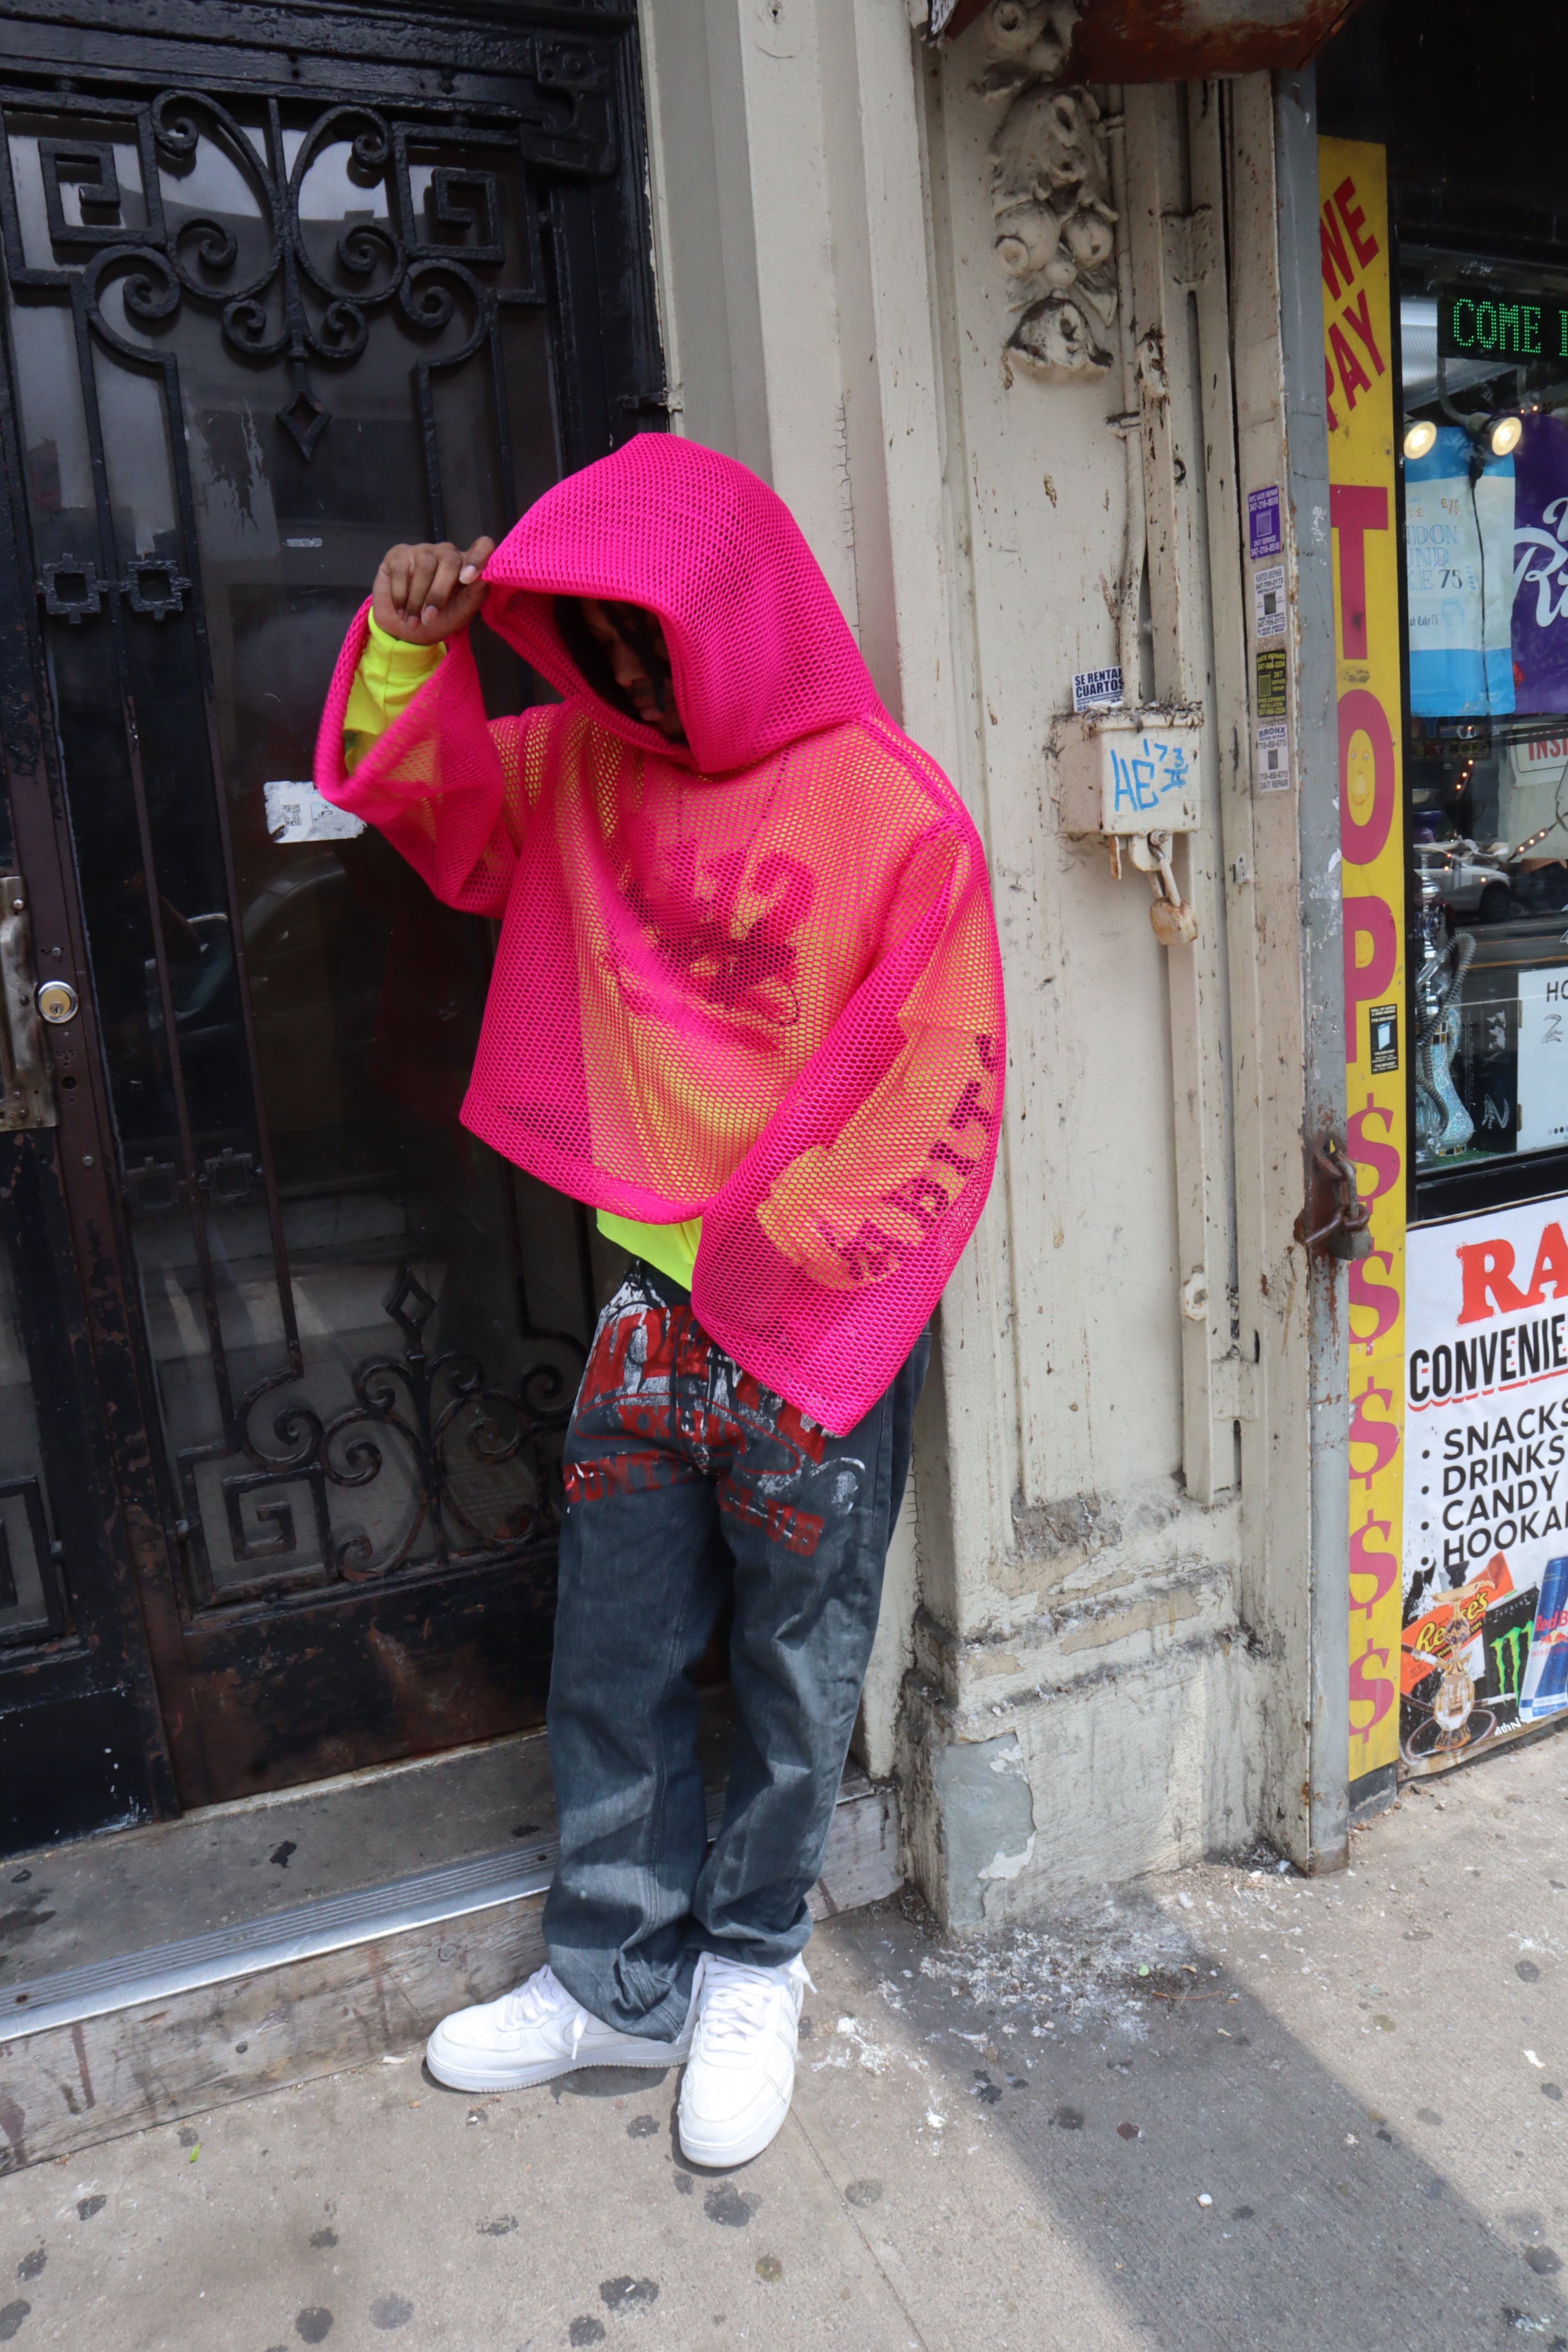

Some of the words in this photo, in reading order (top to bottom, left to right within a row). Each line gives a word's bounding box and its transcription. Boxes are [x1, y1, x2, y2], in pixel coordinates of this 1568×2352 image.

[1453, 298, 1540, 354] COME
[1439, 569, 1462, 589] 75
[1075, 675, 1086, 686] SE
[1076, 678, 1123, 698] CUARTOS
[1258, 727, 1285, 737] BRONX
[1272, 779, 1288, 788] REPAIR
[1443, 1397, 1568, 1461] SNACKS
[1443, 1434, 1565, 1497] DRINKS
[719, 1476, 824, 1557] CLUB
[1442, 1470, 1560, 1531] CANDY
[1443, 1501, 1568, 1568] HOOKA
[1535, 1610, 1559, 1632] Red
